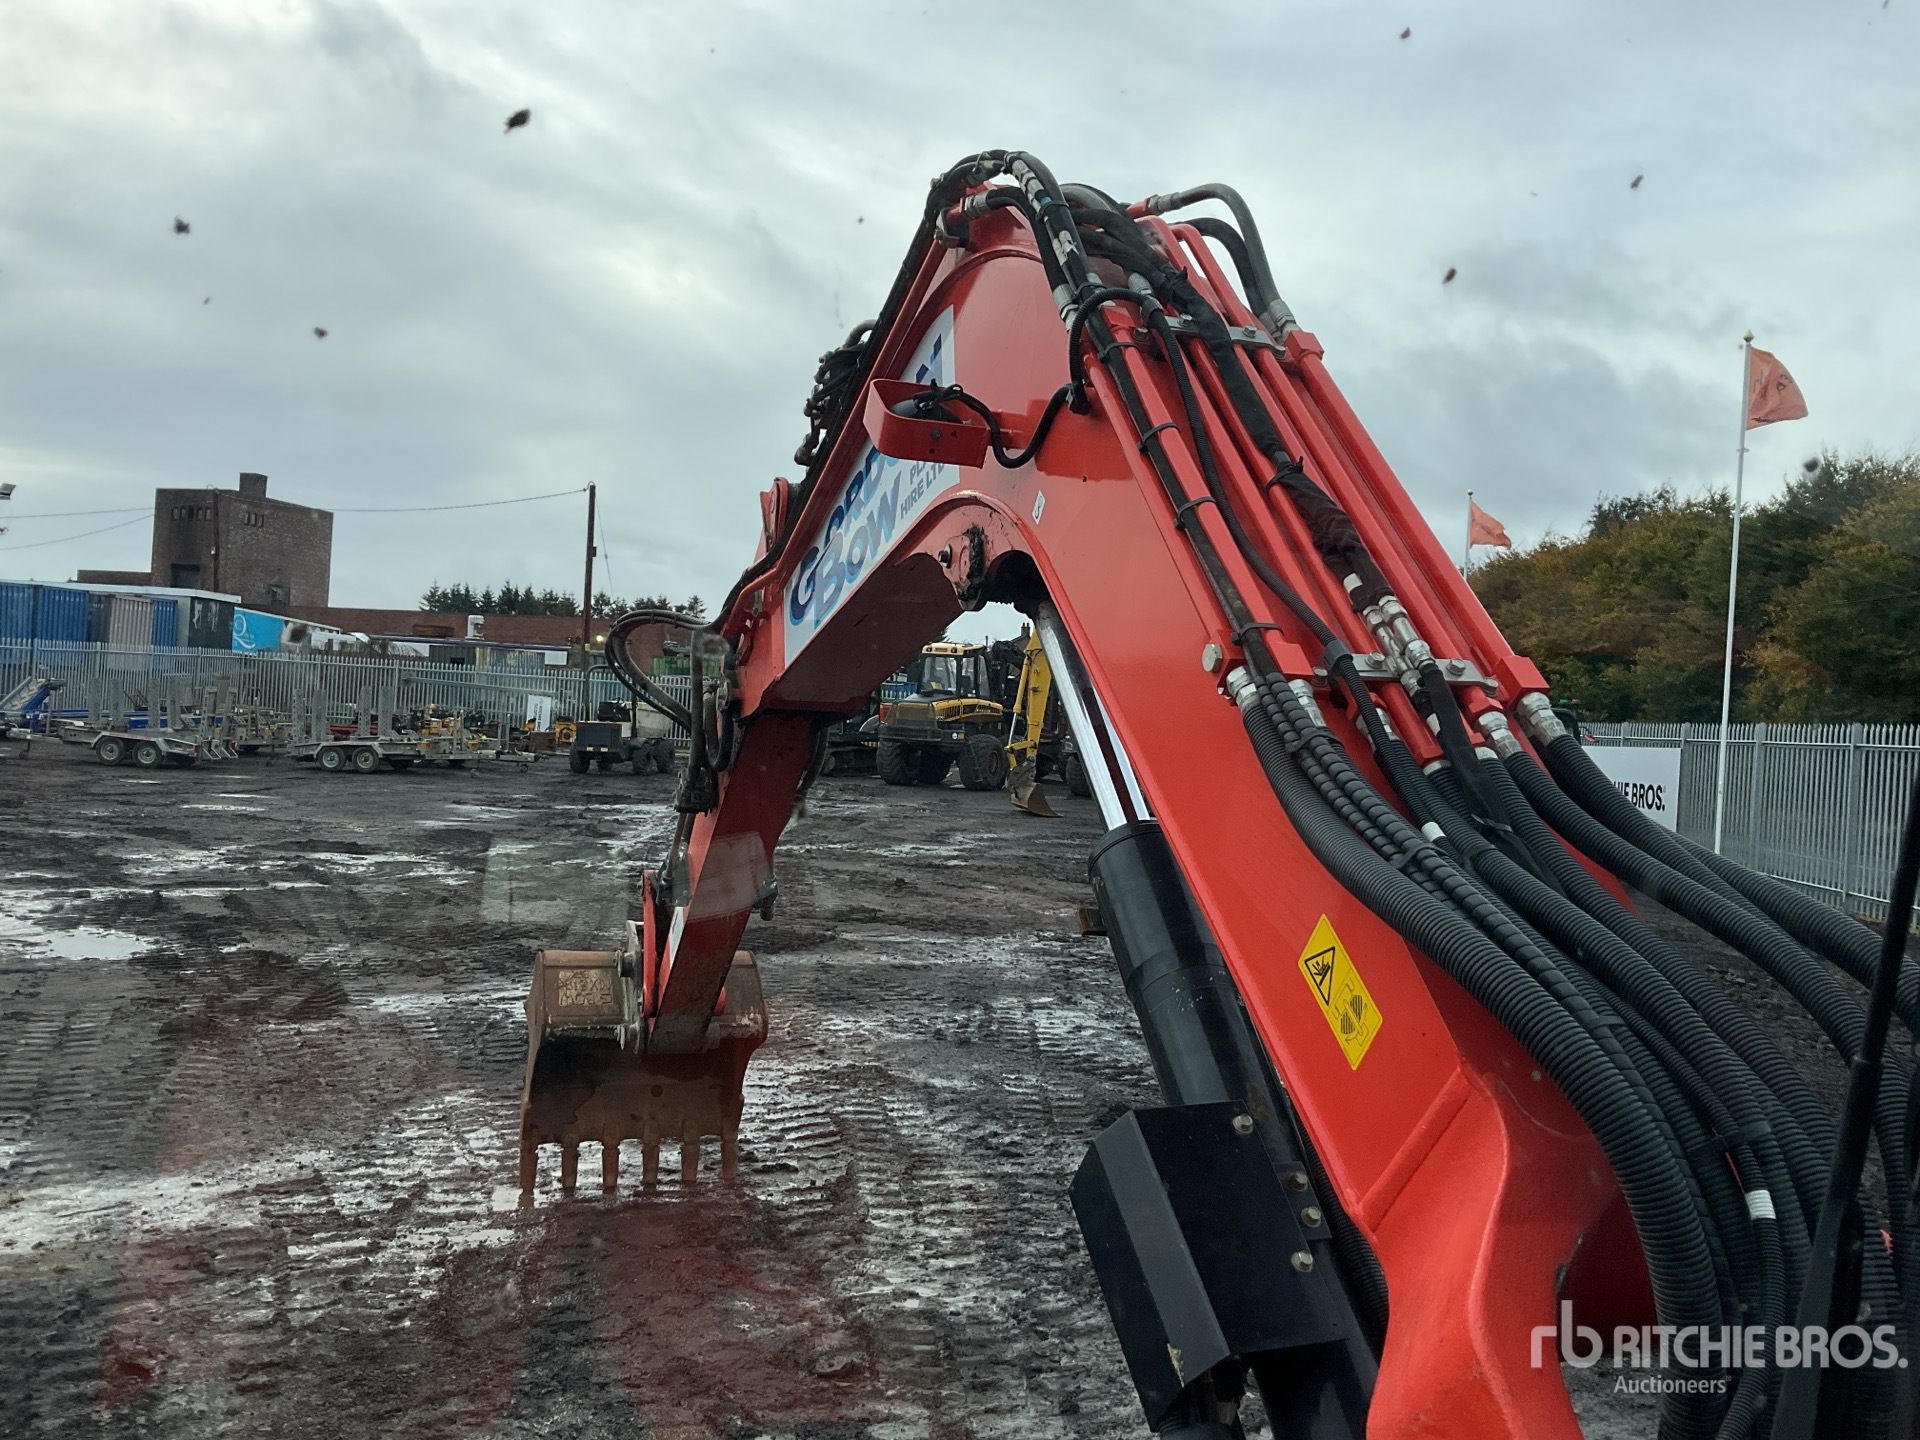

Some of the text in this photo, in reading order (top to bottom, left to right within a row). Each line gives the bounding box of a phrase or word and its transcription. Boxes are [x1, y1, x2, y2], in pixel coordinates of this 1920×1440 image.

[900, 477, 924, 520] HIRE
[813, 470, 902, 630] BOW
[1632, 783, 1665, 811] BROS.
